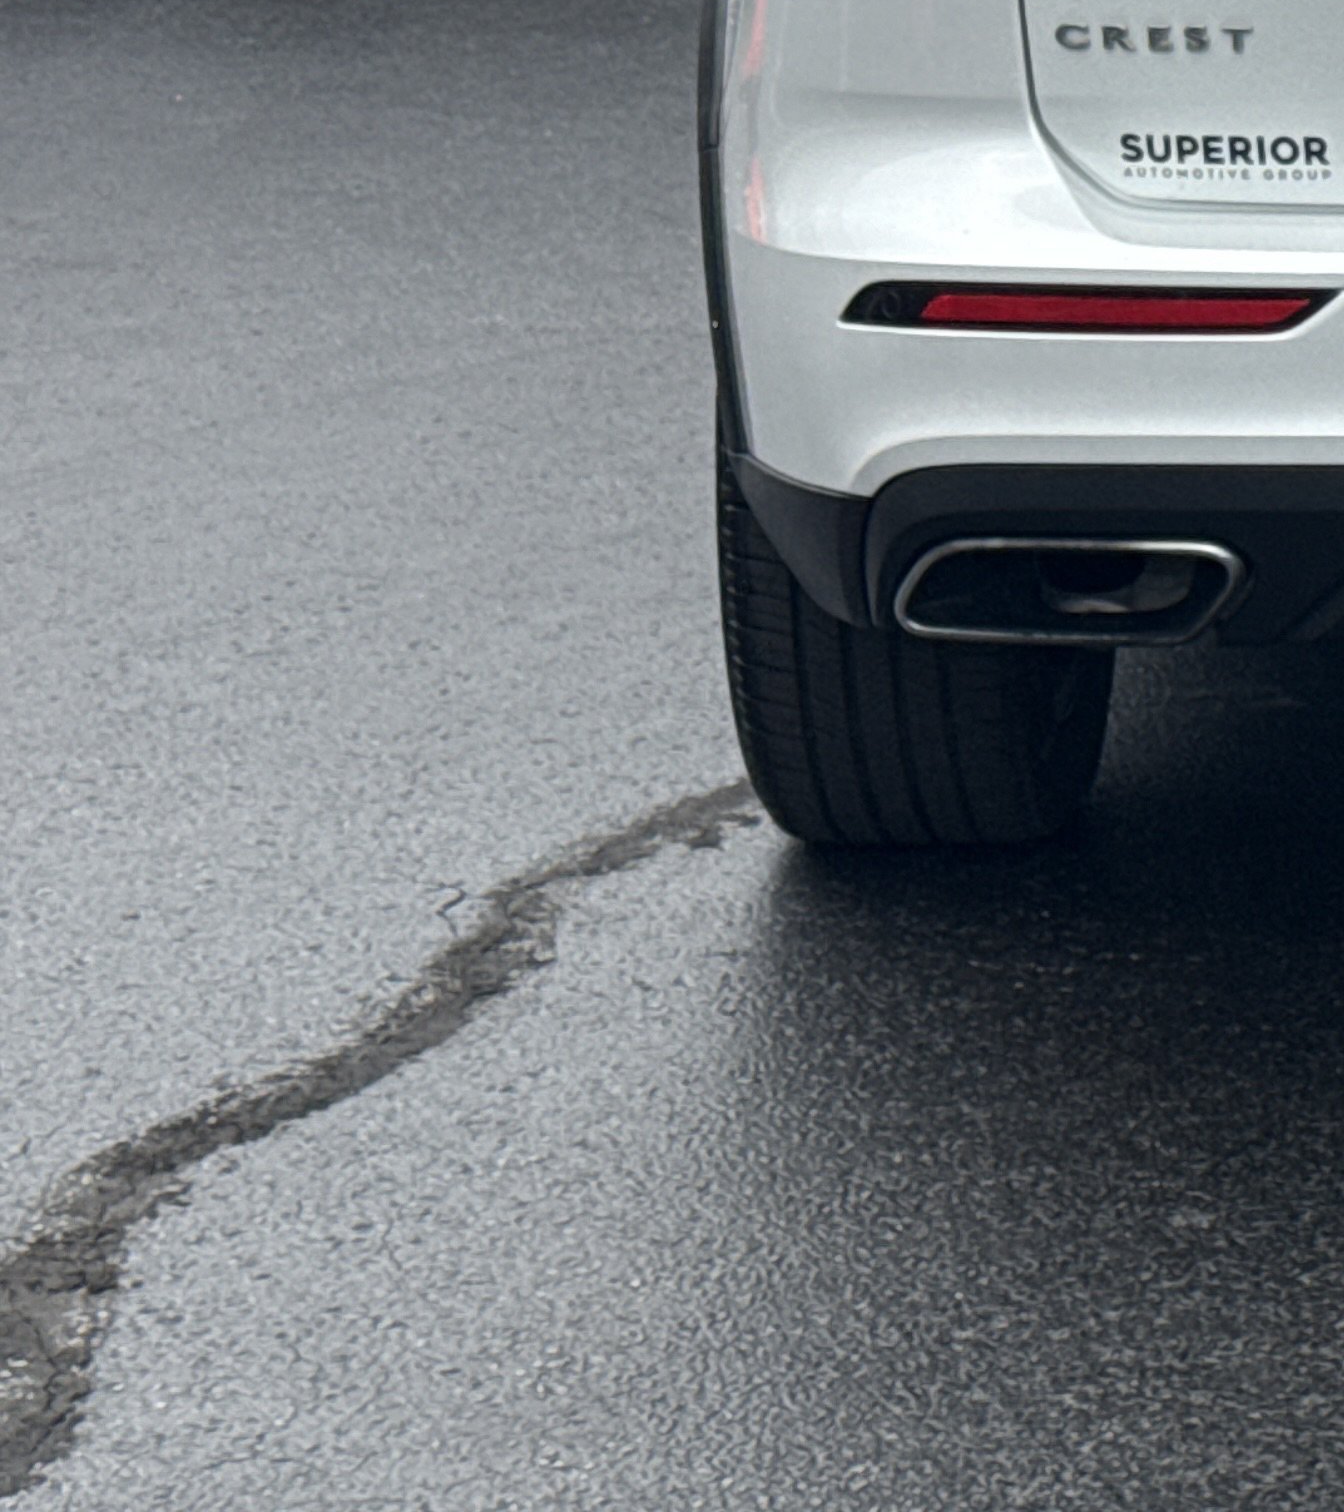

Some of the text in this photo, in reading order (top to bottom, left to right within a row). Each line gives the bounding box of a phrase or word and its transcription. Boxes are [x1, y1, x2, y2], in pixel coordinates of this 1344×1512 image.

[1055, 23, 1254, 54] CREST
[1120, 133, 1330, 166] SUPERIOR
[1124, 167, 1332, 181] AUTOMOTIVE GROUP
